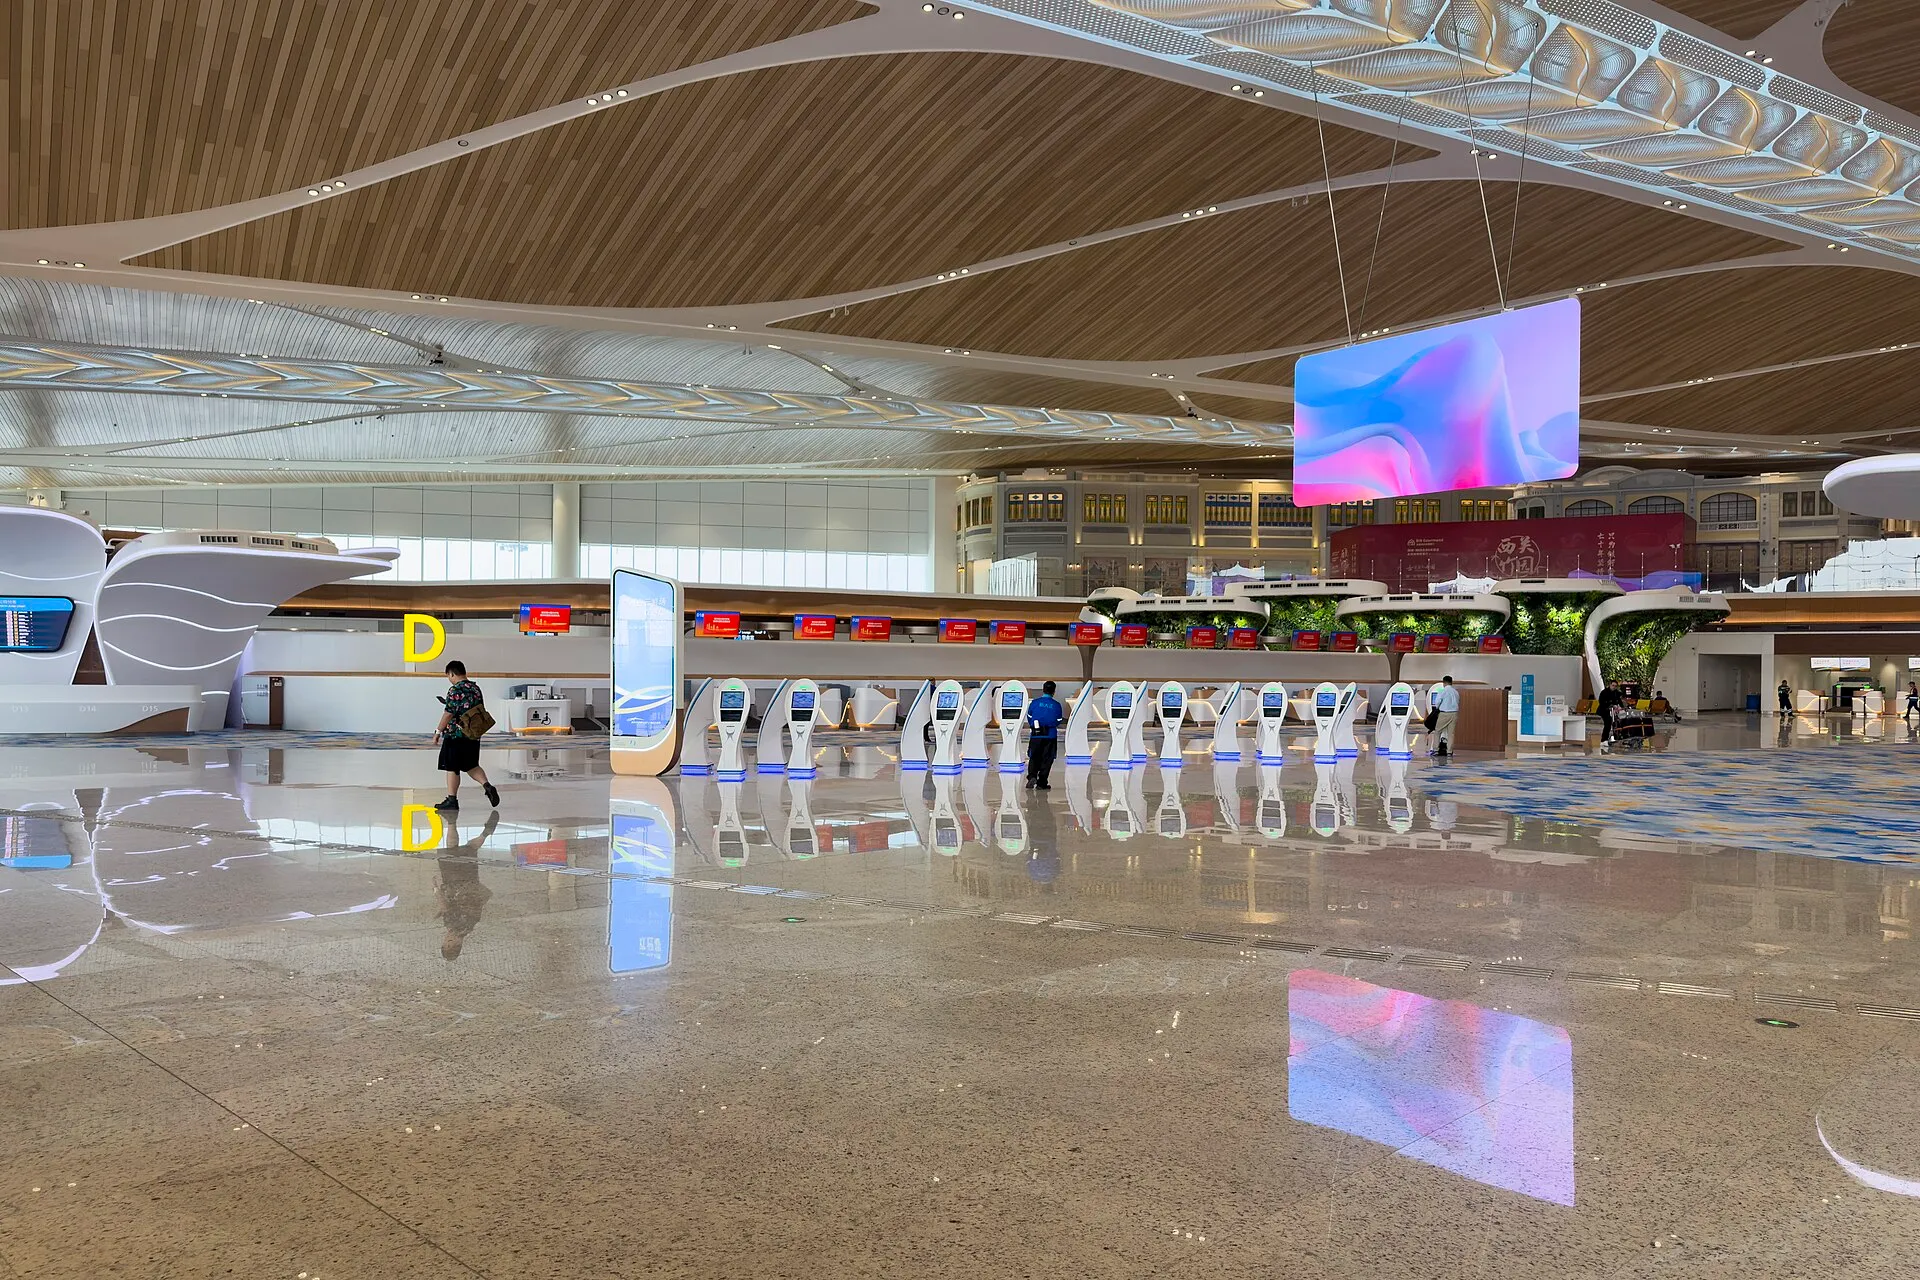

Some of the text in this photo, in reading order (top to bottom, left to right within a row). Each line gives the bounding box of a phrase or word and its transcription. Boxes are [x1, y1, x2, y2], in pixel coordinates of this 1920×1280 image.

[1497, 535, 1535, 555] 西关
[404, 613, 446, 663] D
[79, 705, 97, 713] D14
